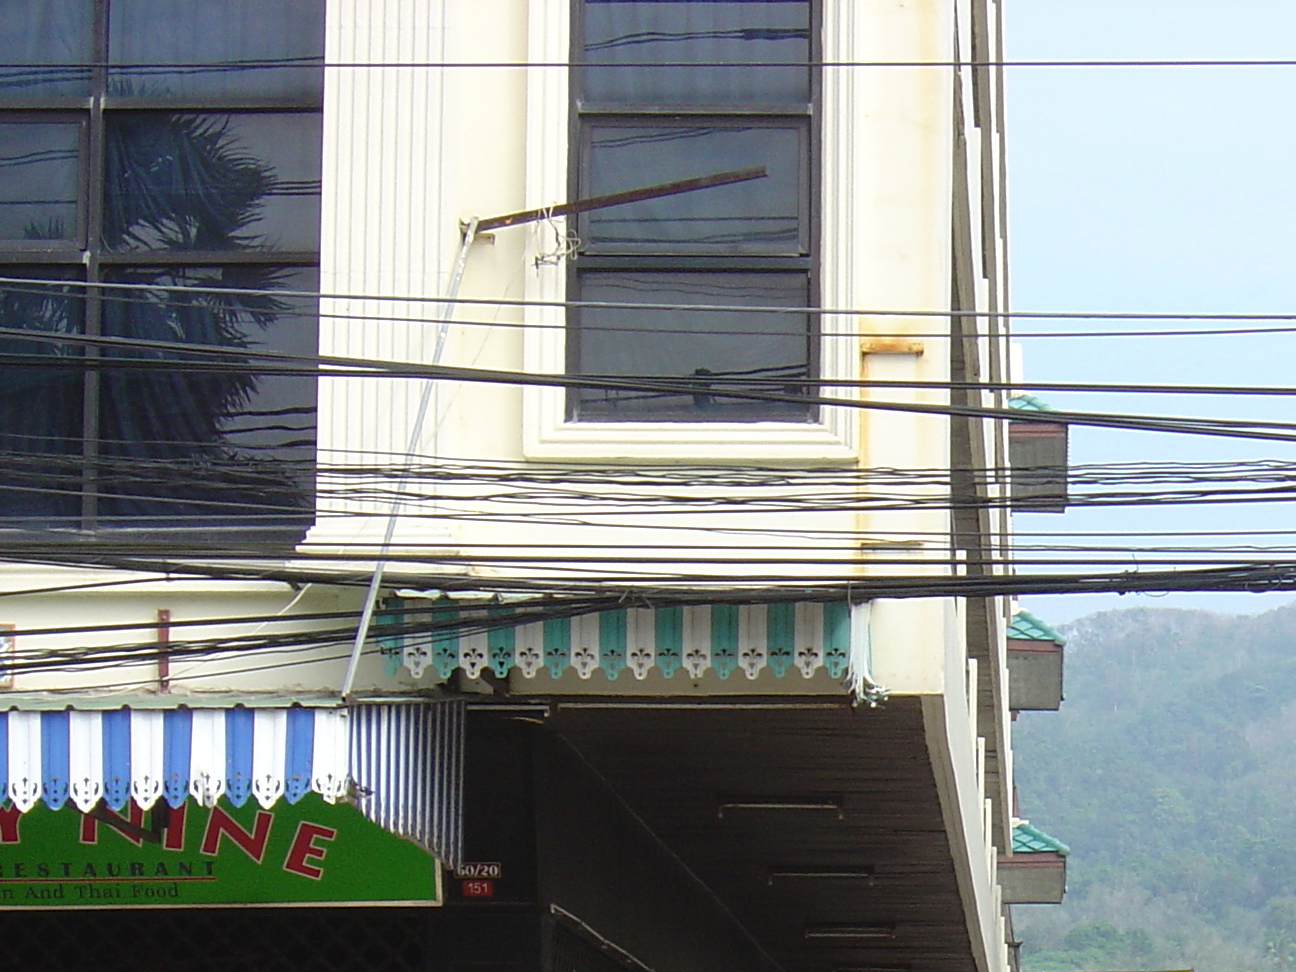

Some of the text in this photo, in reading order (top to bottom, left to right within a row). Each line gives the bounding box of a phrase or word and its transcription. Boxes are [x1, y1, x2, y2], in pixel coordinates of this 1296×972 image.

[25, 884, 64, 899] And
[74, 883, 120, 899] Thai
[132, 882, 179, 899] Food
[467, 882, 489, 894] 151
